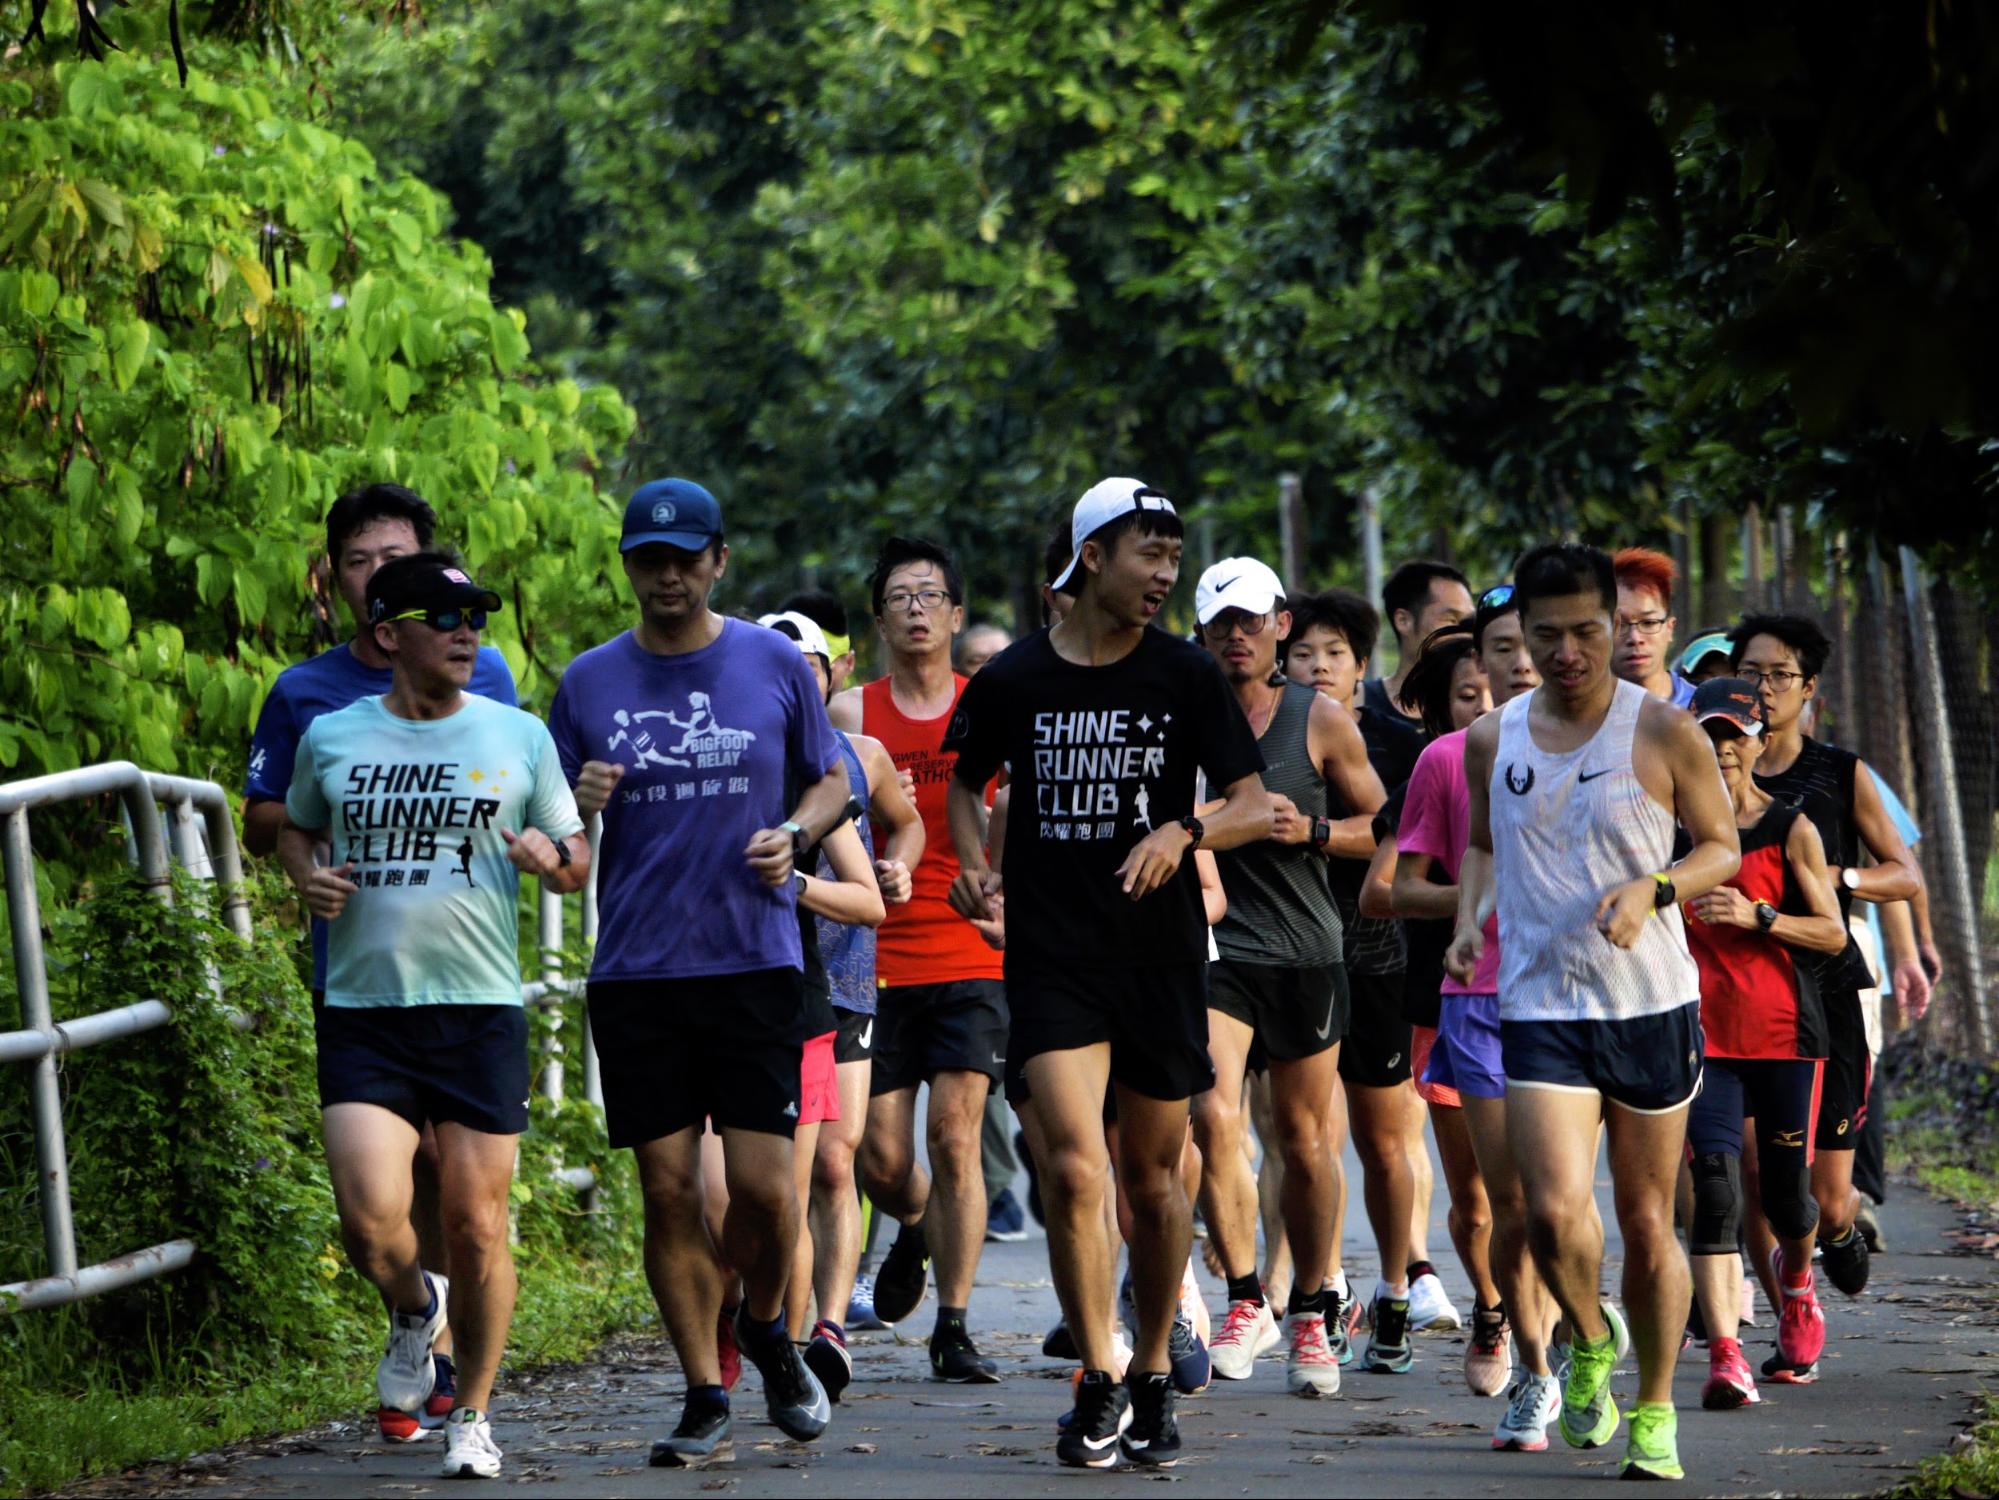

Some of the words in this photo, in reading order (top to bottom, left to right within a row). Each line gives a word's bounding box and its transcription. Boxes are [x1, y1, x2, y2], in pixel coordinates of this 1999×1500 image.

[1034, 710, 1130, 745] SHINE
[690, 734, 750, 754] BIGFOOT
[697, 750, 741, 769] RELAY
[893, 750, 928, 763] GWEN
[344, 763, 459, 795] SHINE
[911, 759, 954, 771] RESERV
[1034, 747, 1165, 780] RUNNER
[342, 797, 501, 831] RUNNER
[1037, 783, 1119, 817] CLUB
[346, 830, 438, 863] CLUB
